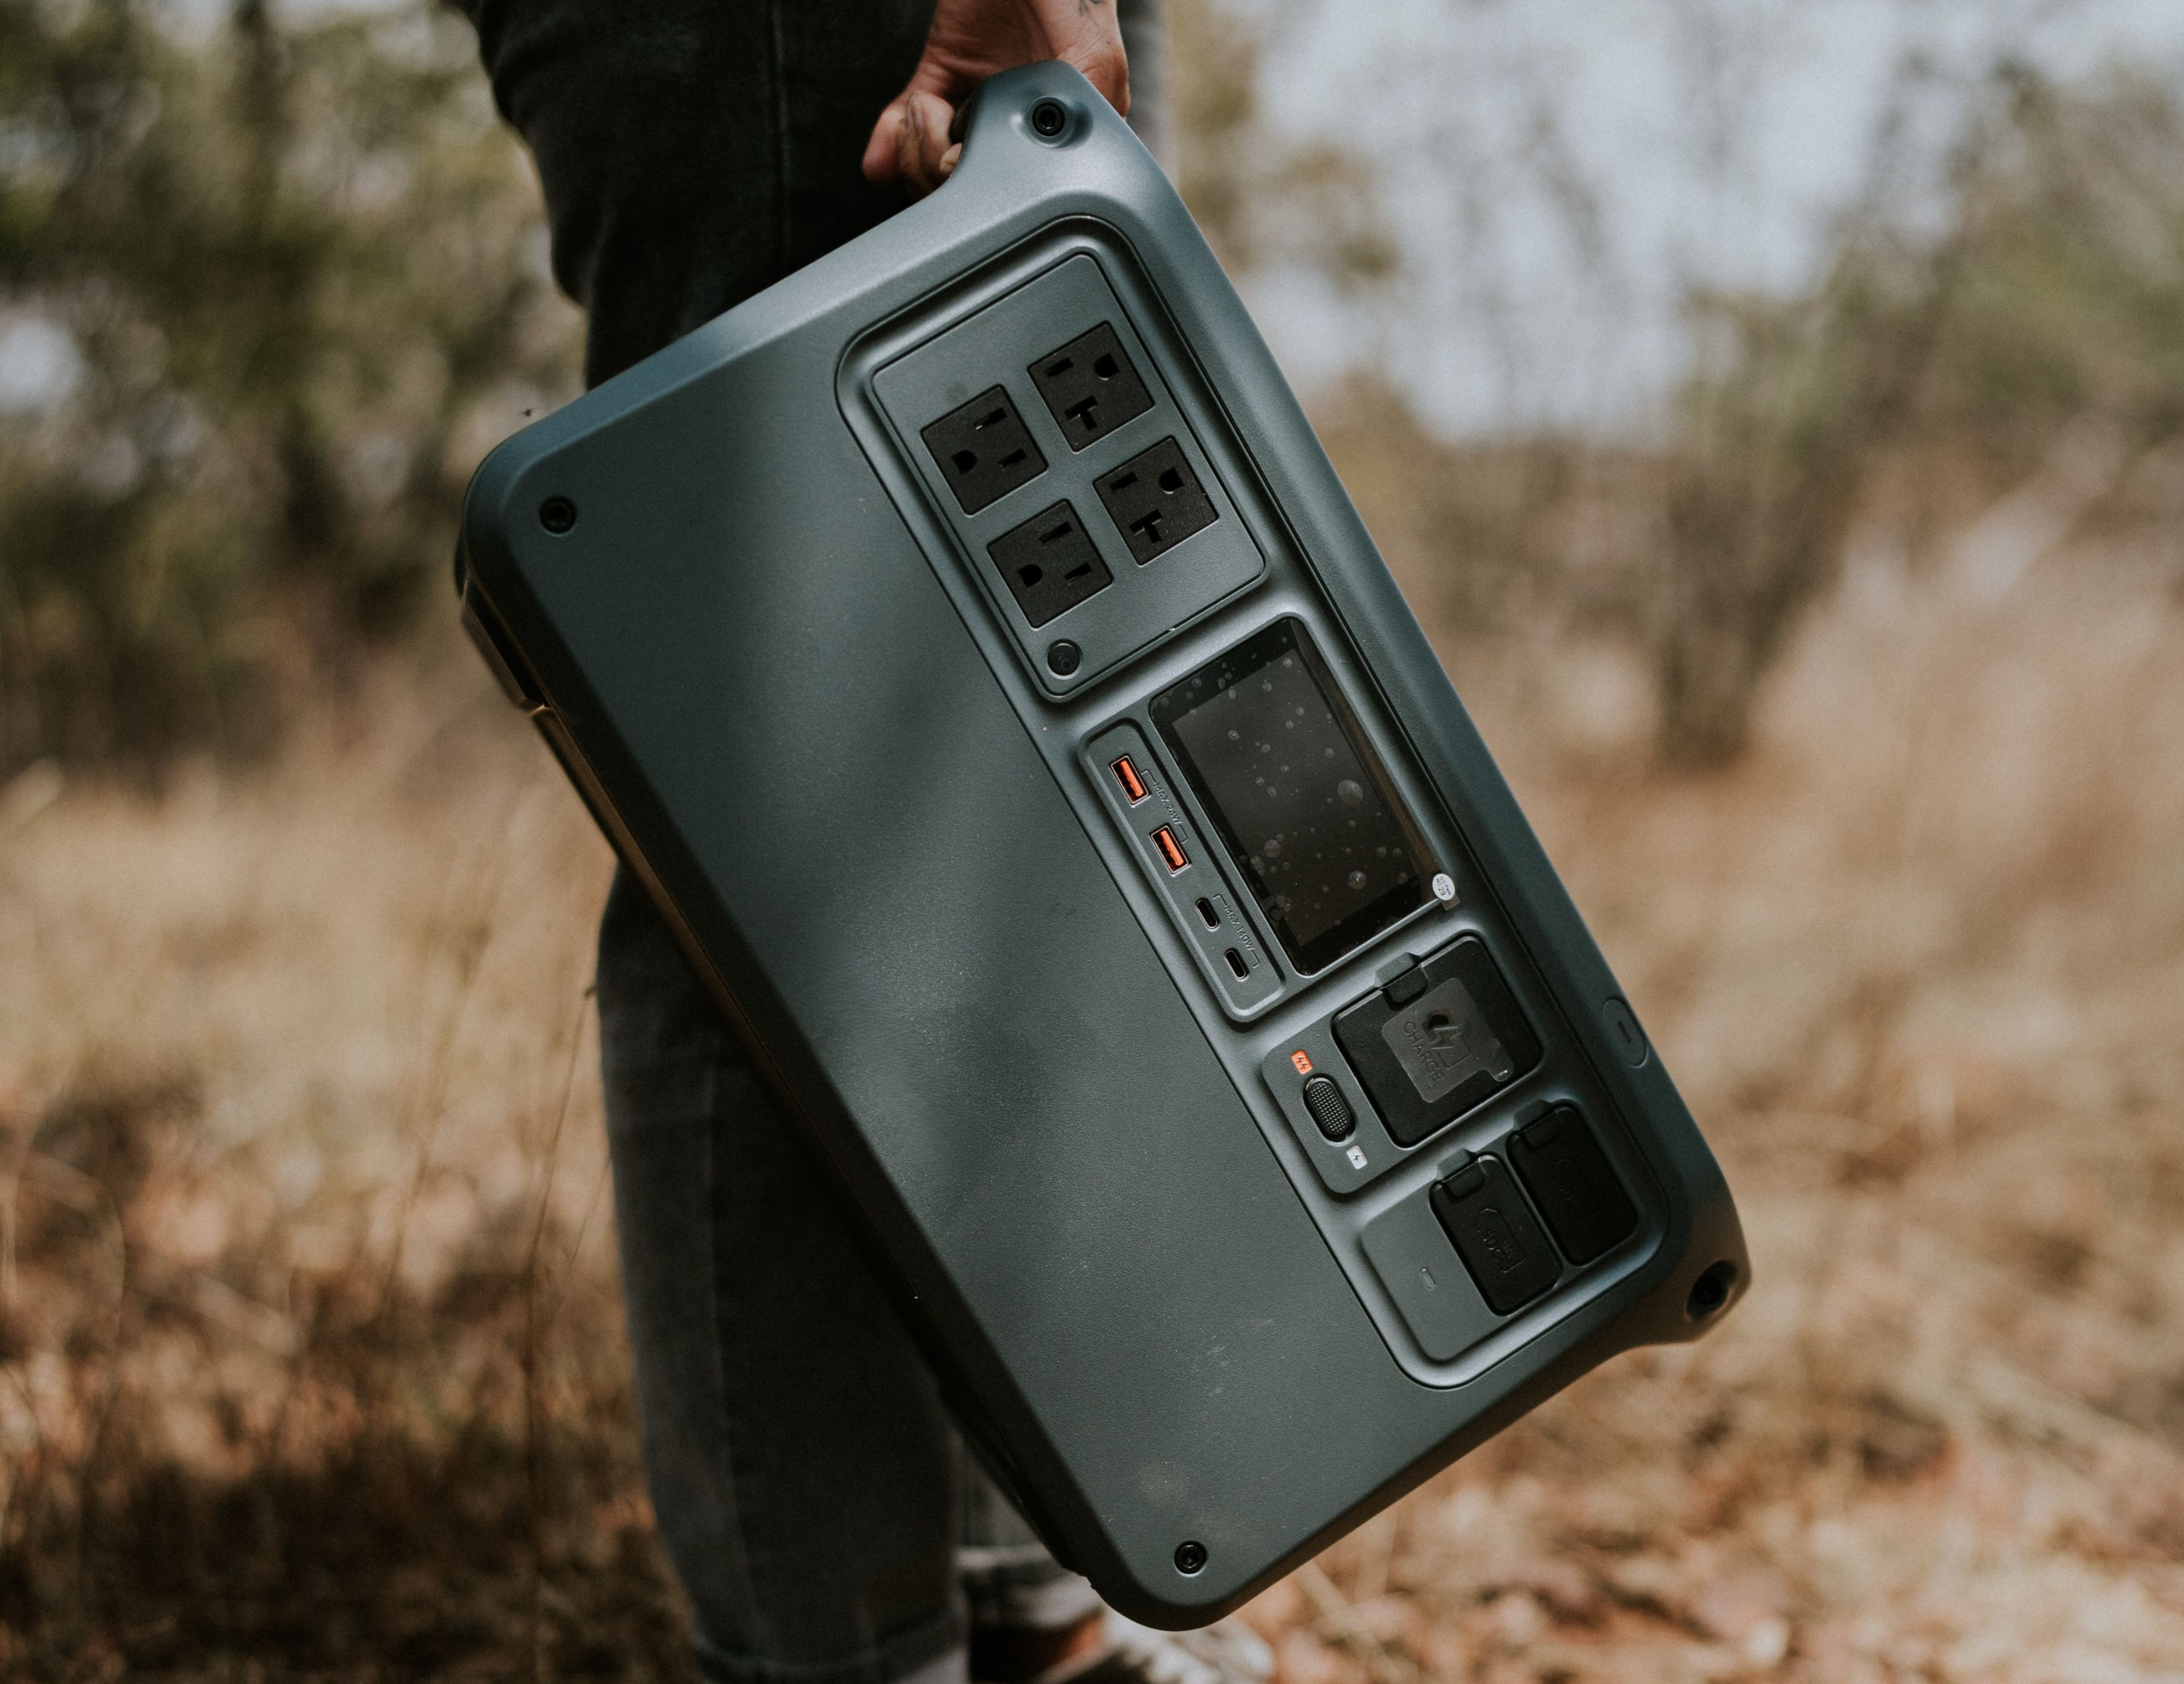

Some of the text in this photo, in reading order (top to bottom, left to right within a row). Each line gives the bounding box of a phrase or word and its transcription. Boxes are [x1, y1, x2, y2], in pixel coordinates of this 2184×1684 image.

[1153, 782, 1183, 825] MAX 24W
[1438, 887, 1446, 896] 29
[1224, 905, 1255, 951] MAX 140W
[1404, 1021, 1445, 1082] CHARGE
